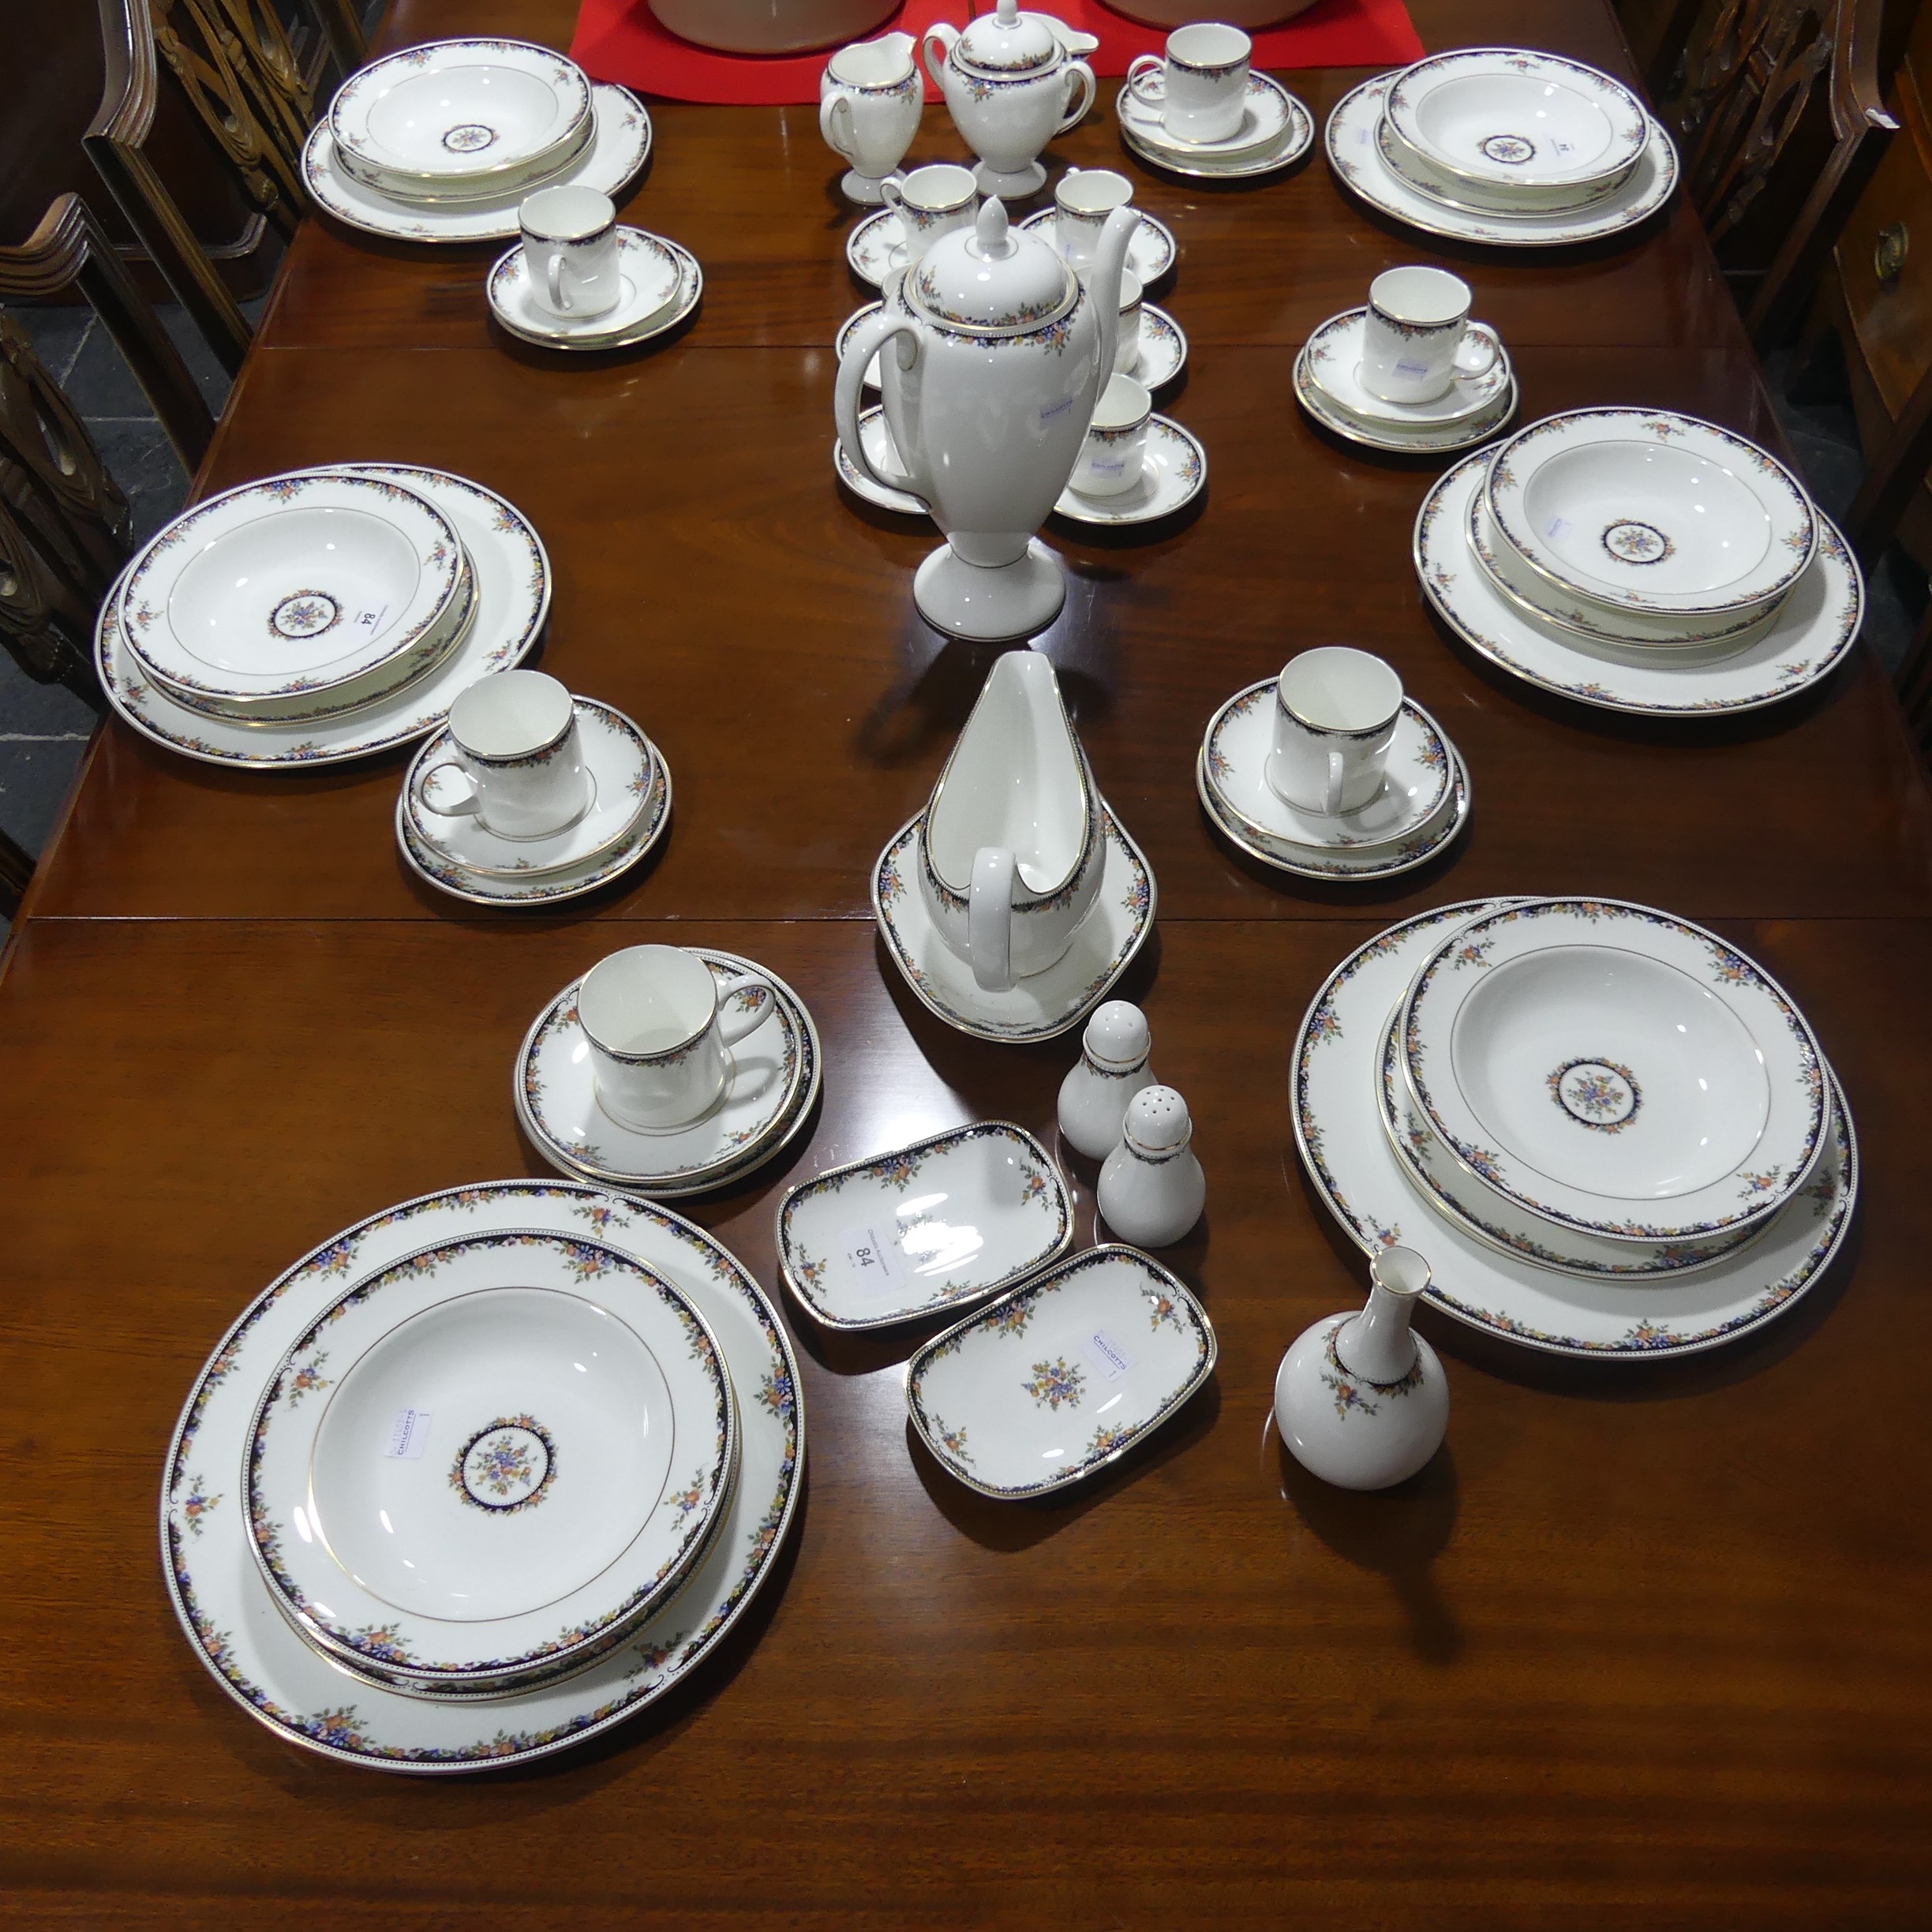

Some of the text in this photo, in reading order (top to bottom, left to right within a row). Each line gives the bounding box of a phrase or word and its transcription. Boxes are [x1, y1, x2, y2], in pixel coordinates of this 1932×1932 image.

[361, 613, 376, 624] 84
[856, 1248, 875, 1267] 84
[1094, 1335, 1127, 1370] CHILCOTTS
[398, 1410, 414, 1455] CHILCOTTS
